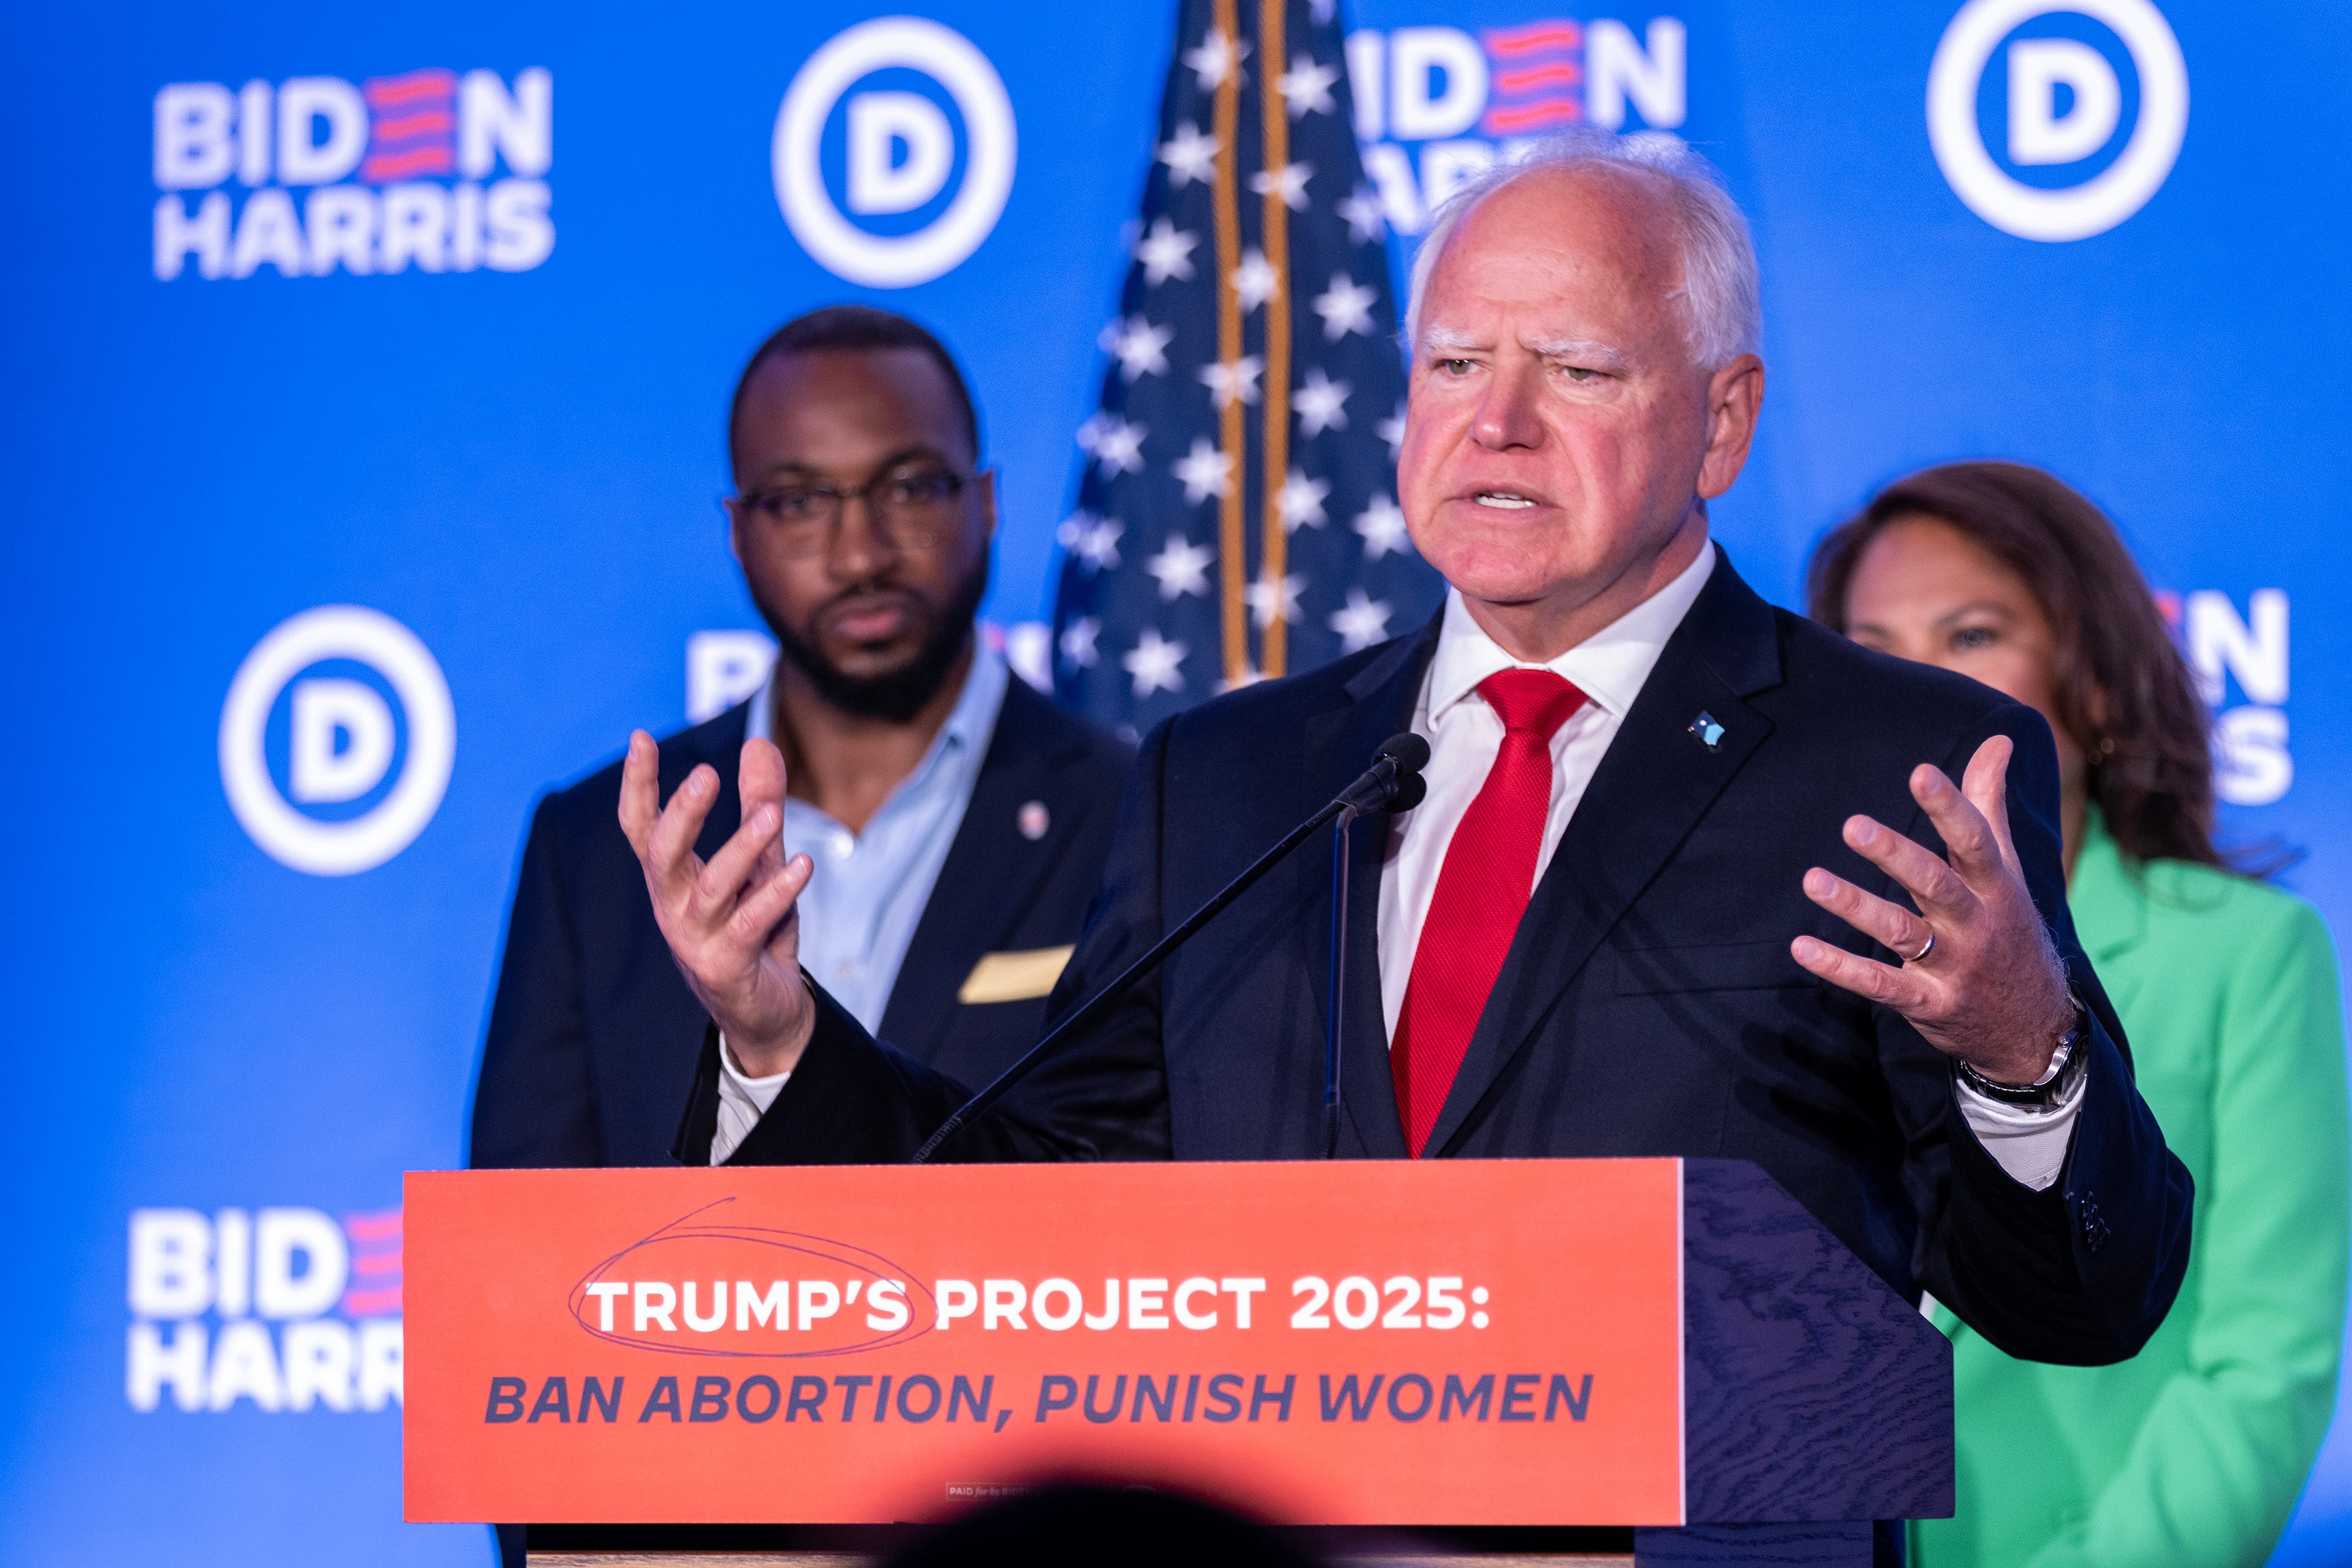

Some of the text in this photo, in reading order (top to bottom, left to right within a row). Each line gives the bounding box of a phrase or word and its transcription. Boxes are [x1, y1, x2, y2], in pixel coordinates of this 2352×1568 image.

[154, 68, 553, 188] BIDEN
[1345, 17, 1686, 137] IDEN
[2007, 37, 2121, 165] D
[847, 90, 955, 216] D
[154, 178, 555, 280] HARRIS
[290, 678, 395, 803] D
[128, 1205, 403, 1319] BIDE
[585, 1275, 1490, 1333] TRUMP'S PROJECT 2025:
[127, 1318, 403, 1412] HARR
[484, 1373, 1594, 1433] BAN ABORTION, PUNISH WOMEN
[949, 1487, 973, 1495] PAID
[973, 1486, 988, 1497] for
[990, 1486, 1001, 1497] by
